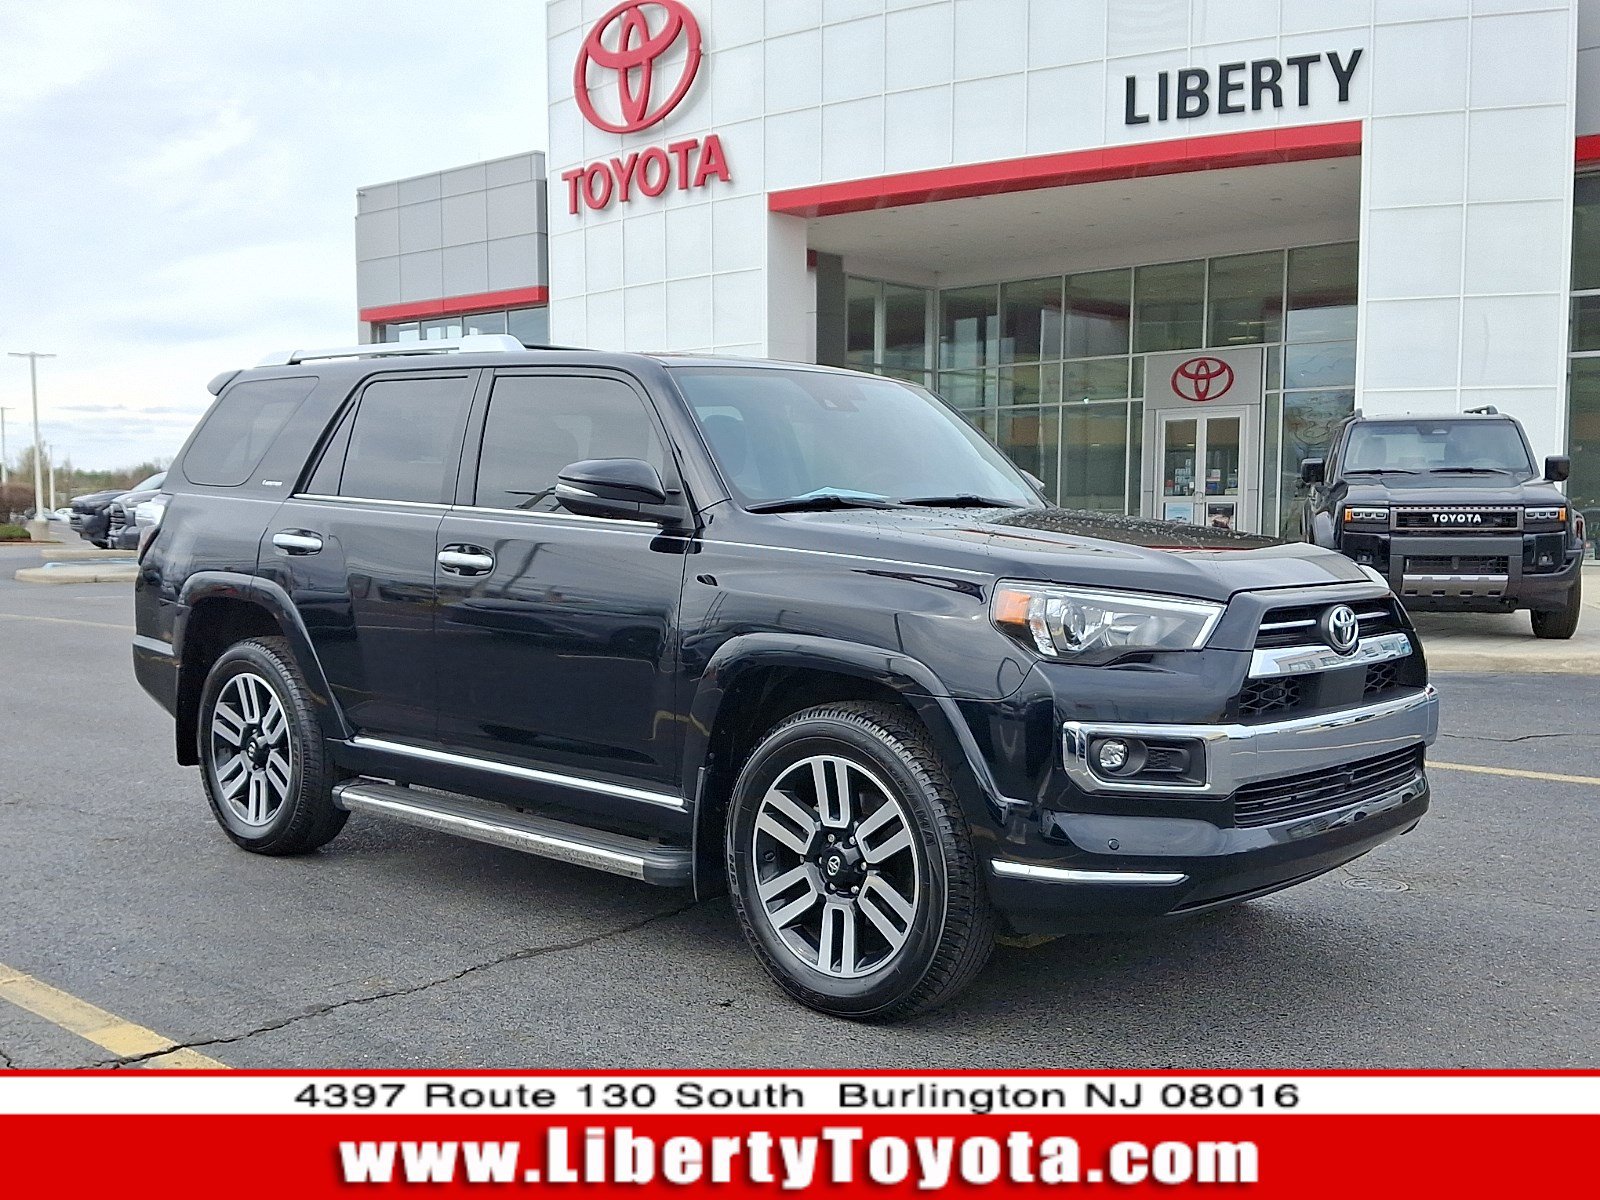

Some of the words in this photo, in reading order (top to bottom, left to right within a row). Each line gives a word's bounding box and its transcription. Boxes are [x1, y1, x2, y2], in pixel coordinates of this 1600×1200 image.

[1125, 49, 1363, 125] LIBERTY
[562, 134, 732, 215] TOYOTA
[1432, 513, 1482, 524] TOYOTA
